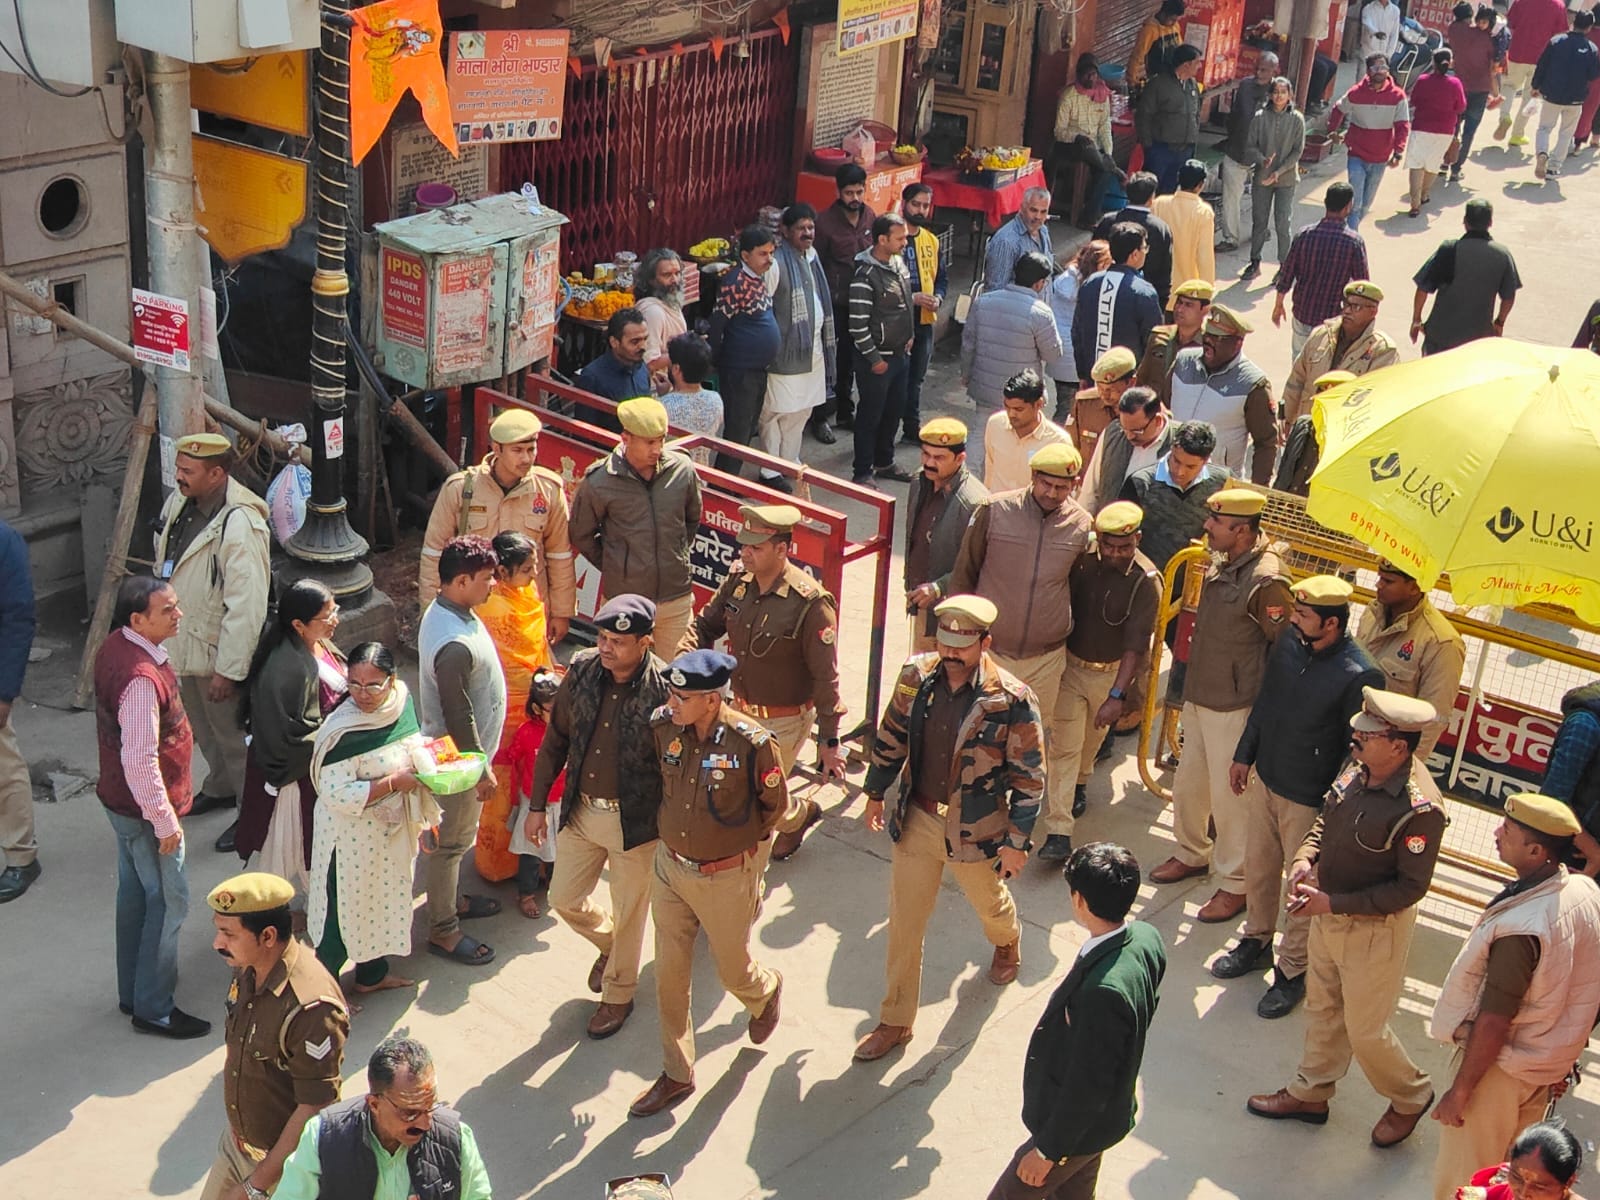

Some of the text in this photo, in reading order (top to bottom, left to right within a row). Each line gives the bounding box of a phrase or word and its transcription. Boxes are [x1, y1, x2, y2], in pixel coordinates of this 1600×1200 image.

[503, 32, 519, 52] श्री
[456, 55, 561, 75] माला भोग भण्डार
[387, 256, 422, 279] IPDS
[448, 259, 488, 273] DANGER
[390, 276, 418, 292] DANGER
[136, 295, 184, 312] NO PARKING
[388, 288, 422, 306] 440 VOLT
[1402, 467, 1455, 517] U&i
[1532, 510, 1593, 552] U&i
[1383, 532, 1397, 548] TO
[1401, 544, 1422, 568] WIN
